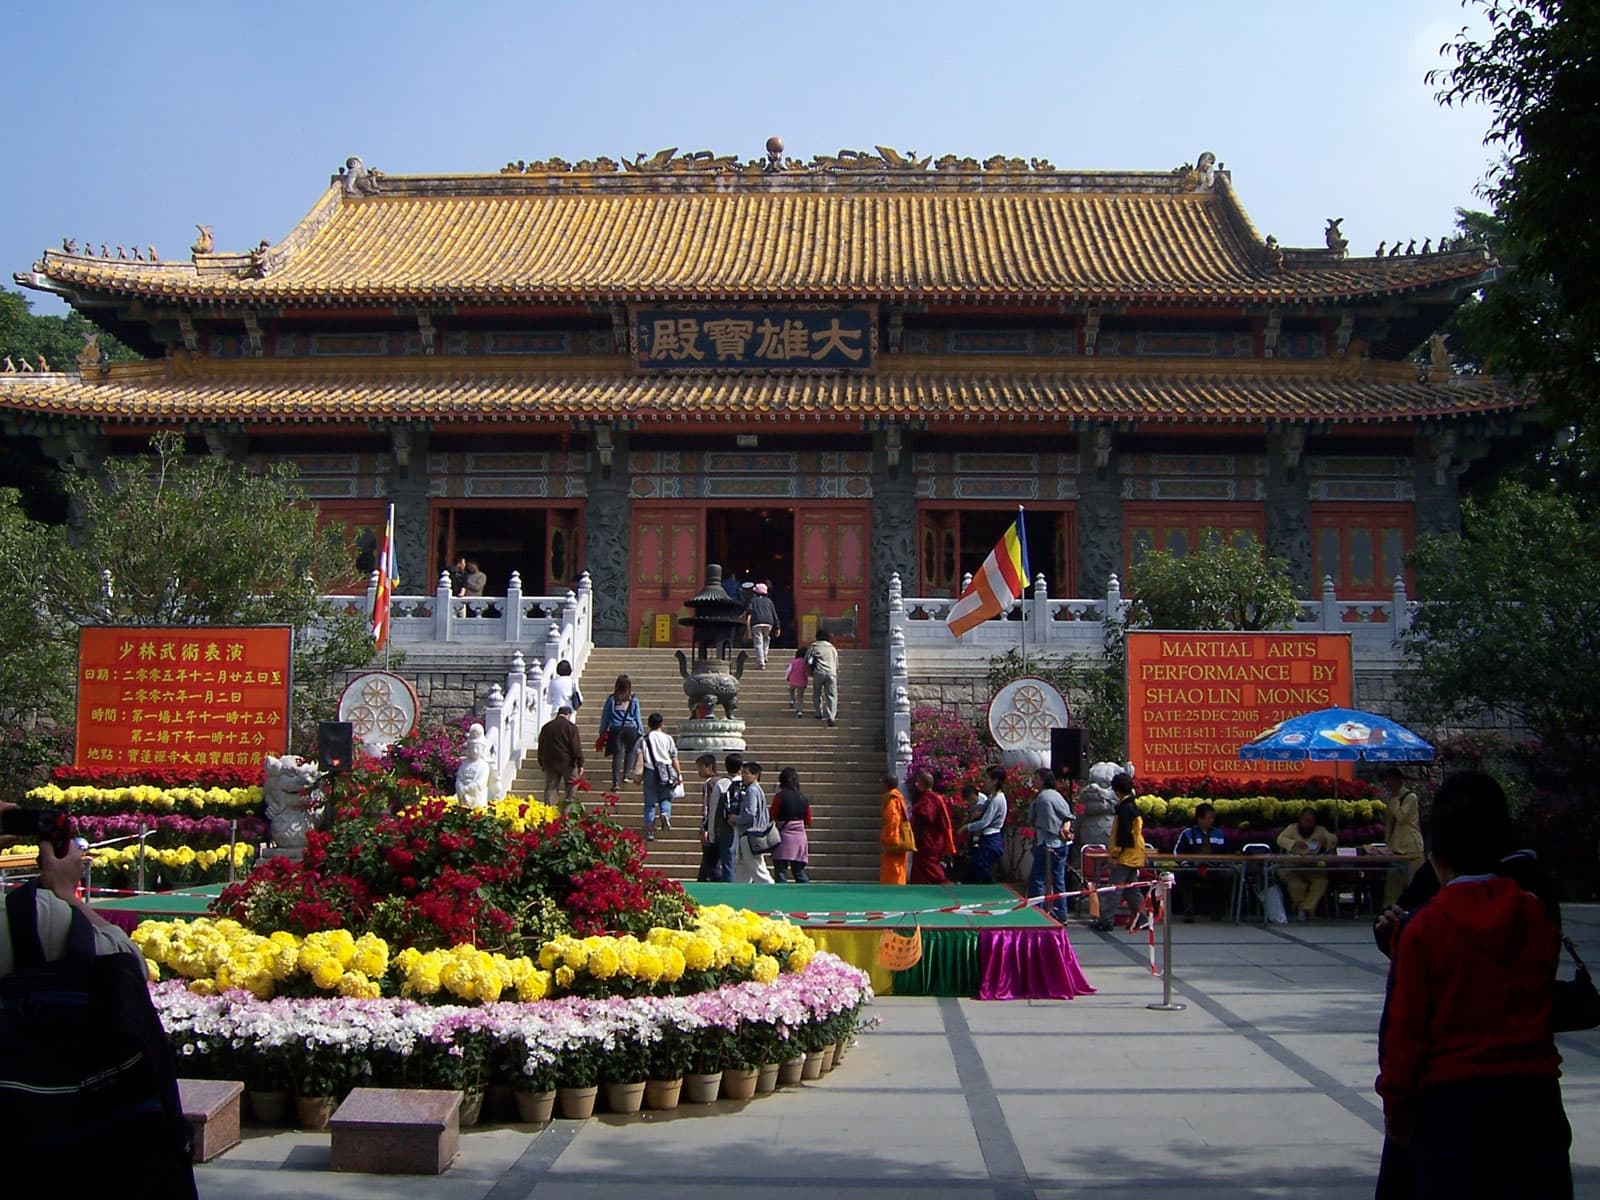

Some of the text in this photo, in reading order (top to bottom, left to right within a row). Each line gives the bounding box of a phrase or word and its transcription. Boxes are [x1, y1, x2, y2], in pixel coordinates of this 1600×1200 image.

[119, 641, 244, 662] 少林武術表演
[1162, 641, 1317, 657] MARTIAL ARTS
[1142, 664, 1336, 681] PERFORMANCE BY
[1257, 687, 1330, 704] MONKS
[1201, 709, 1231, 721] DEC
[1231, 709, 1260, 722] 2005
[1144, 760, 1184, 772] HALL
[1189, 760, 1207, 772] OF
[1266, 760, 1305, 772] HERO
